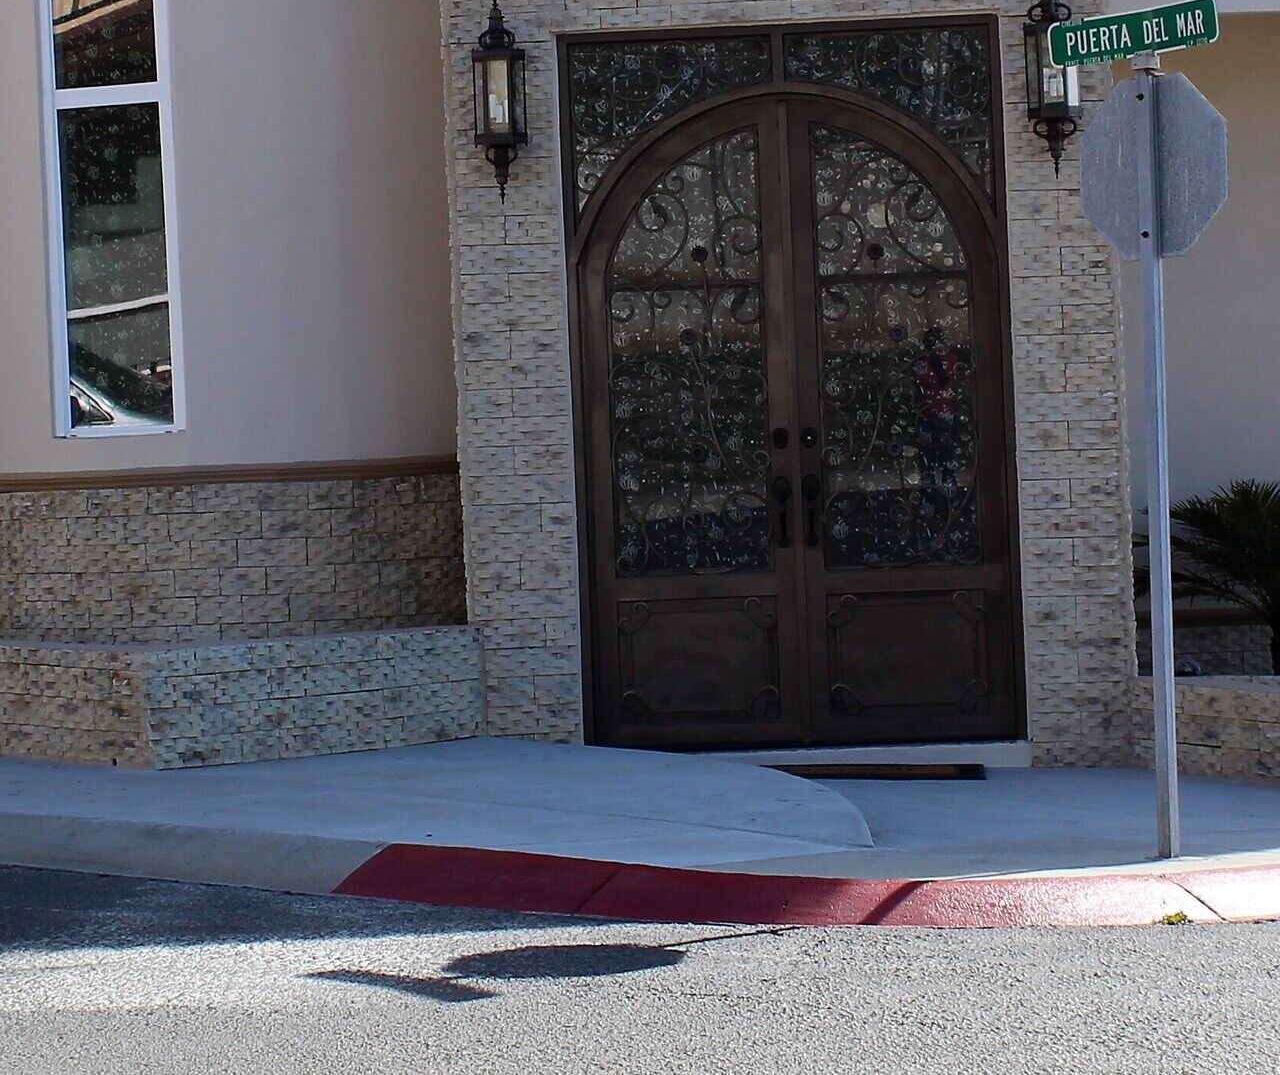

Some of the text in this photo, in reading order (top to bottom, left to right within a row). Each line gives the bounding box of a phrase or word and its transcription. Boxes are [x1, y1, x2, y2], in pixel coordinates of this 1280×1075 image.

[1065, 9, 1205, 56] PUERTA DEL MAR
